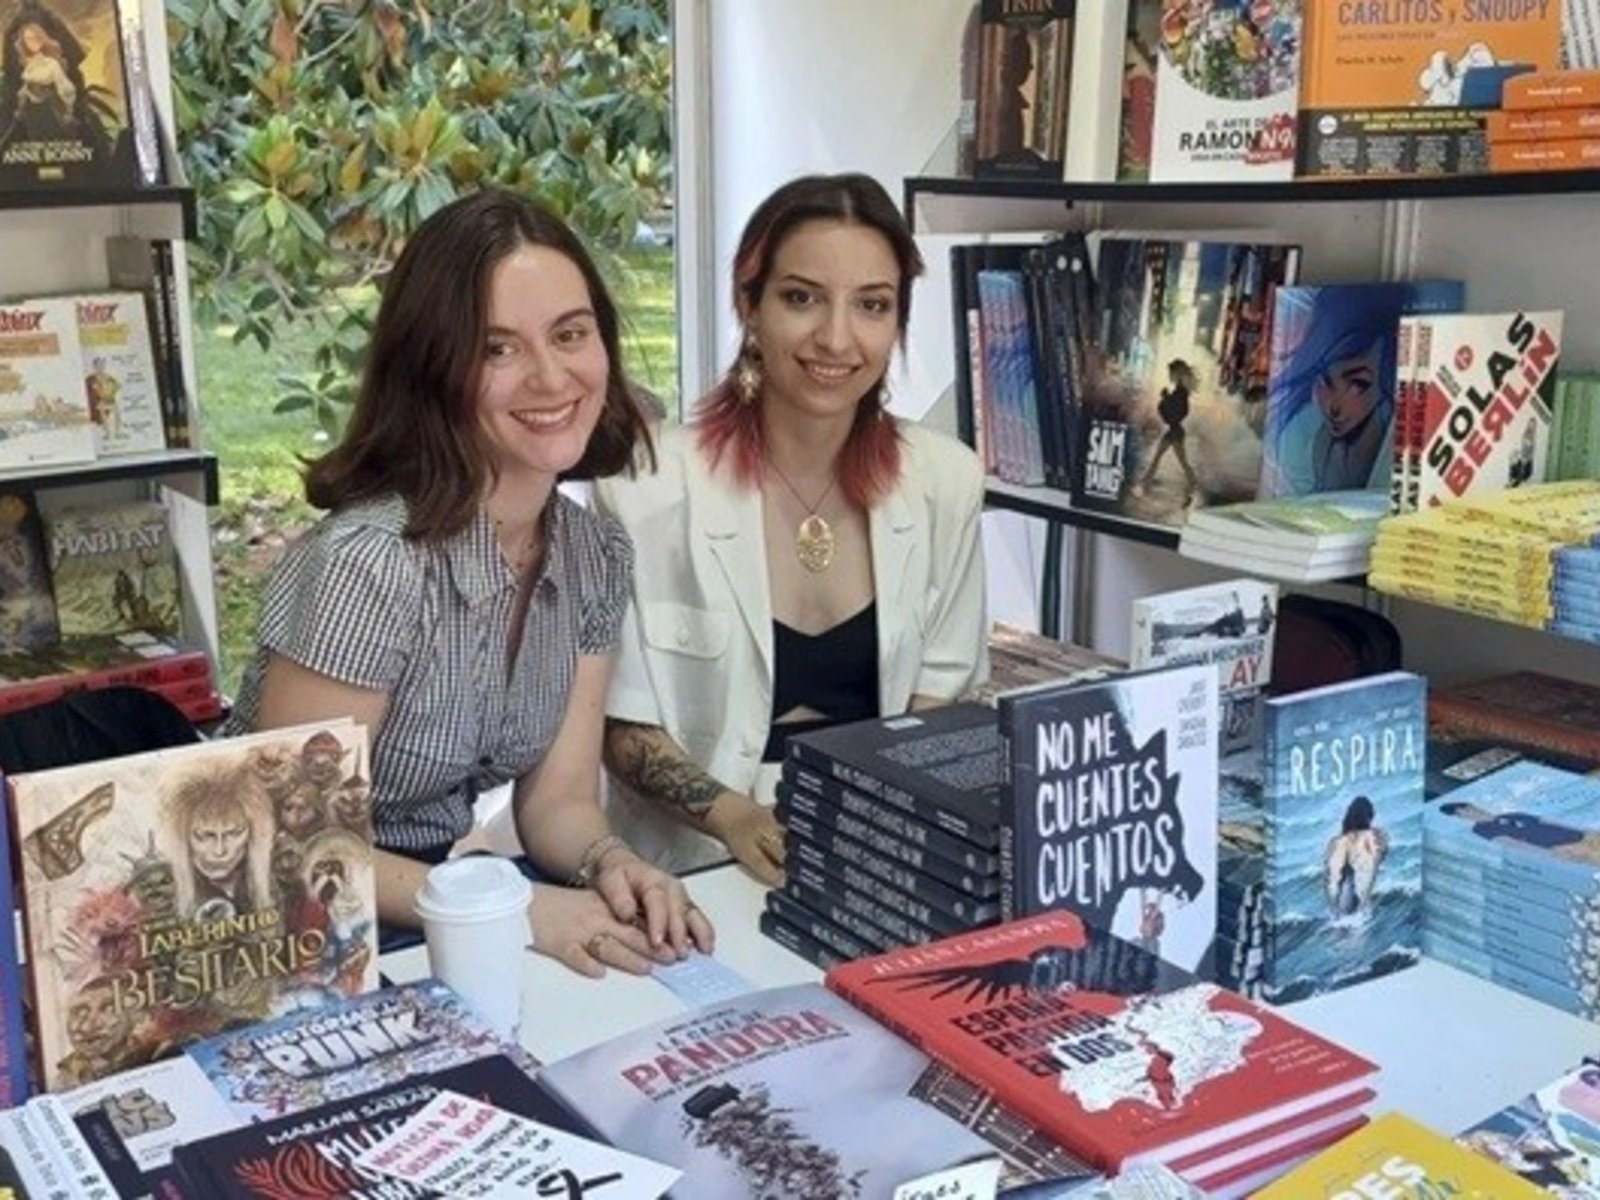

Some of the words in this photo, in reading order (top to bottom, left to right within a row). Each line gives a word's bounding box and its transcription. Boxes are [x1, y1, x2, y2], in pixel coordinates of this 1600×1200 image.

[1339, 0, 1442, 25] CARLITOS
[1463, 0, 1549, 22] SNOOPY
[1428, 312, 1535, 477] SOLAS
[53, 524, 165, 562] HABITAT
[1037, 718, 1075, 775] NO
[1082, 712, 1119, 764] ME
[1290, 724, 1417, 795] RESPIRA
[1036, 757, 1162, 837] CUENTES
[1037, 813, 1176, 908] CUENTOS
[111, 929, 326, 1015] BESTIARIO
[262, 1010, 438, 1077] PUNK
[621, 1010, 845, 1096] PANDORA
[980, 1009, 1116, 1058] PARTIDA
[1014, 1052, 1072, 1077] EN
[1057, 1032, 1135, 1065] DOS
